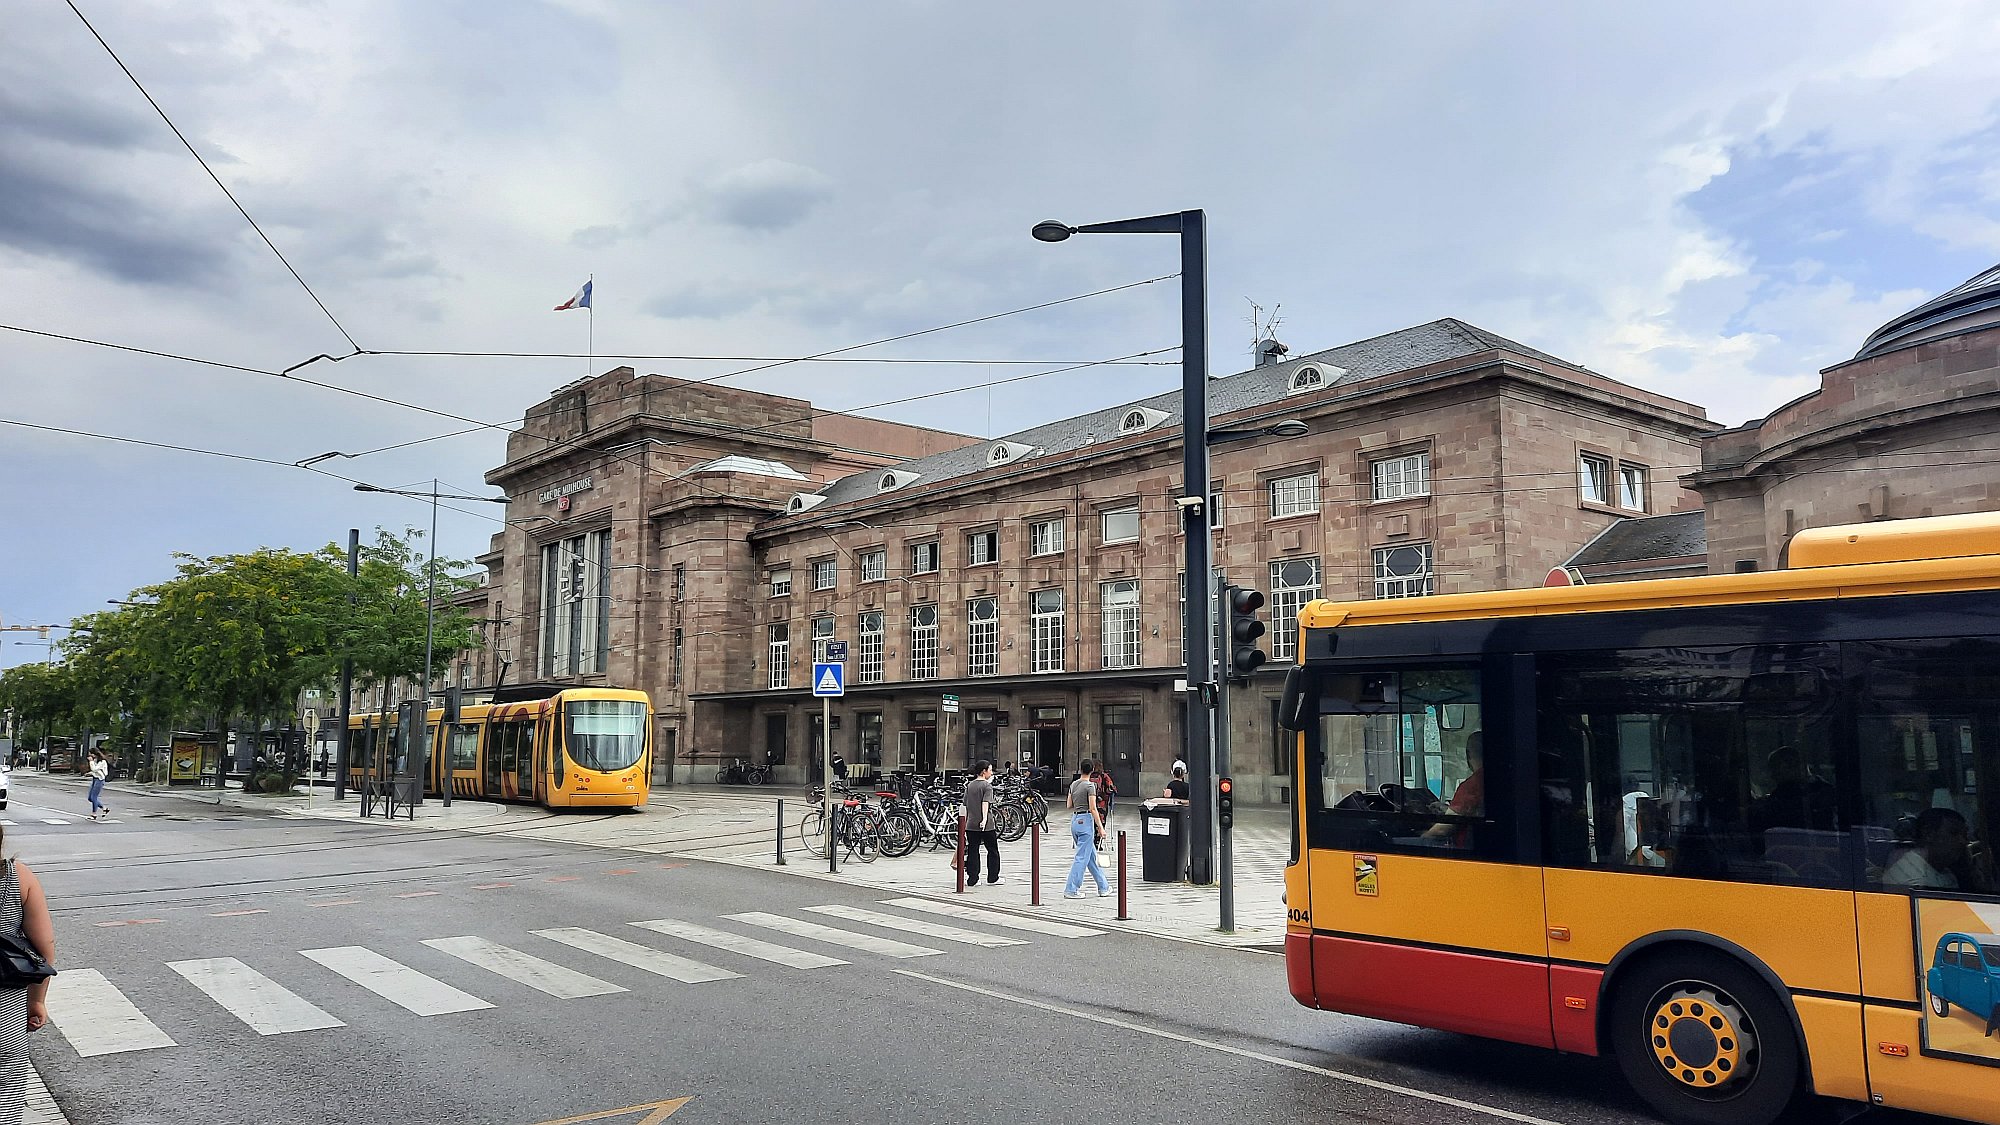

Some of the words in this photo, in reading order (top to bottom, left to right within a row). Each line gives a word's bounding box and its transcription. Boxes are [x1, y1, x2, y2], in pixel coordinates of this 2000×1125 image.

[538, 490, 553, 502] GARE
[553, 487, 561, 498] DE
[561, 476, 592, 495] MULHOUSE
[1287, 908, 1309, 923] 404
